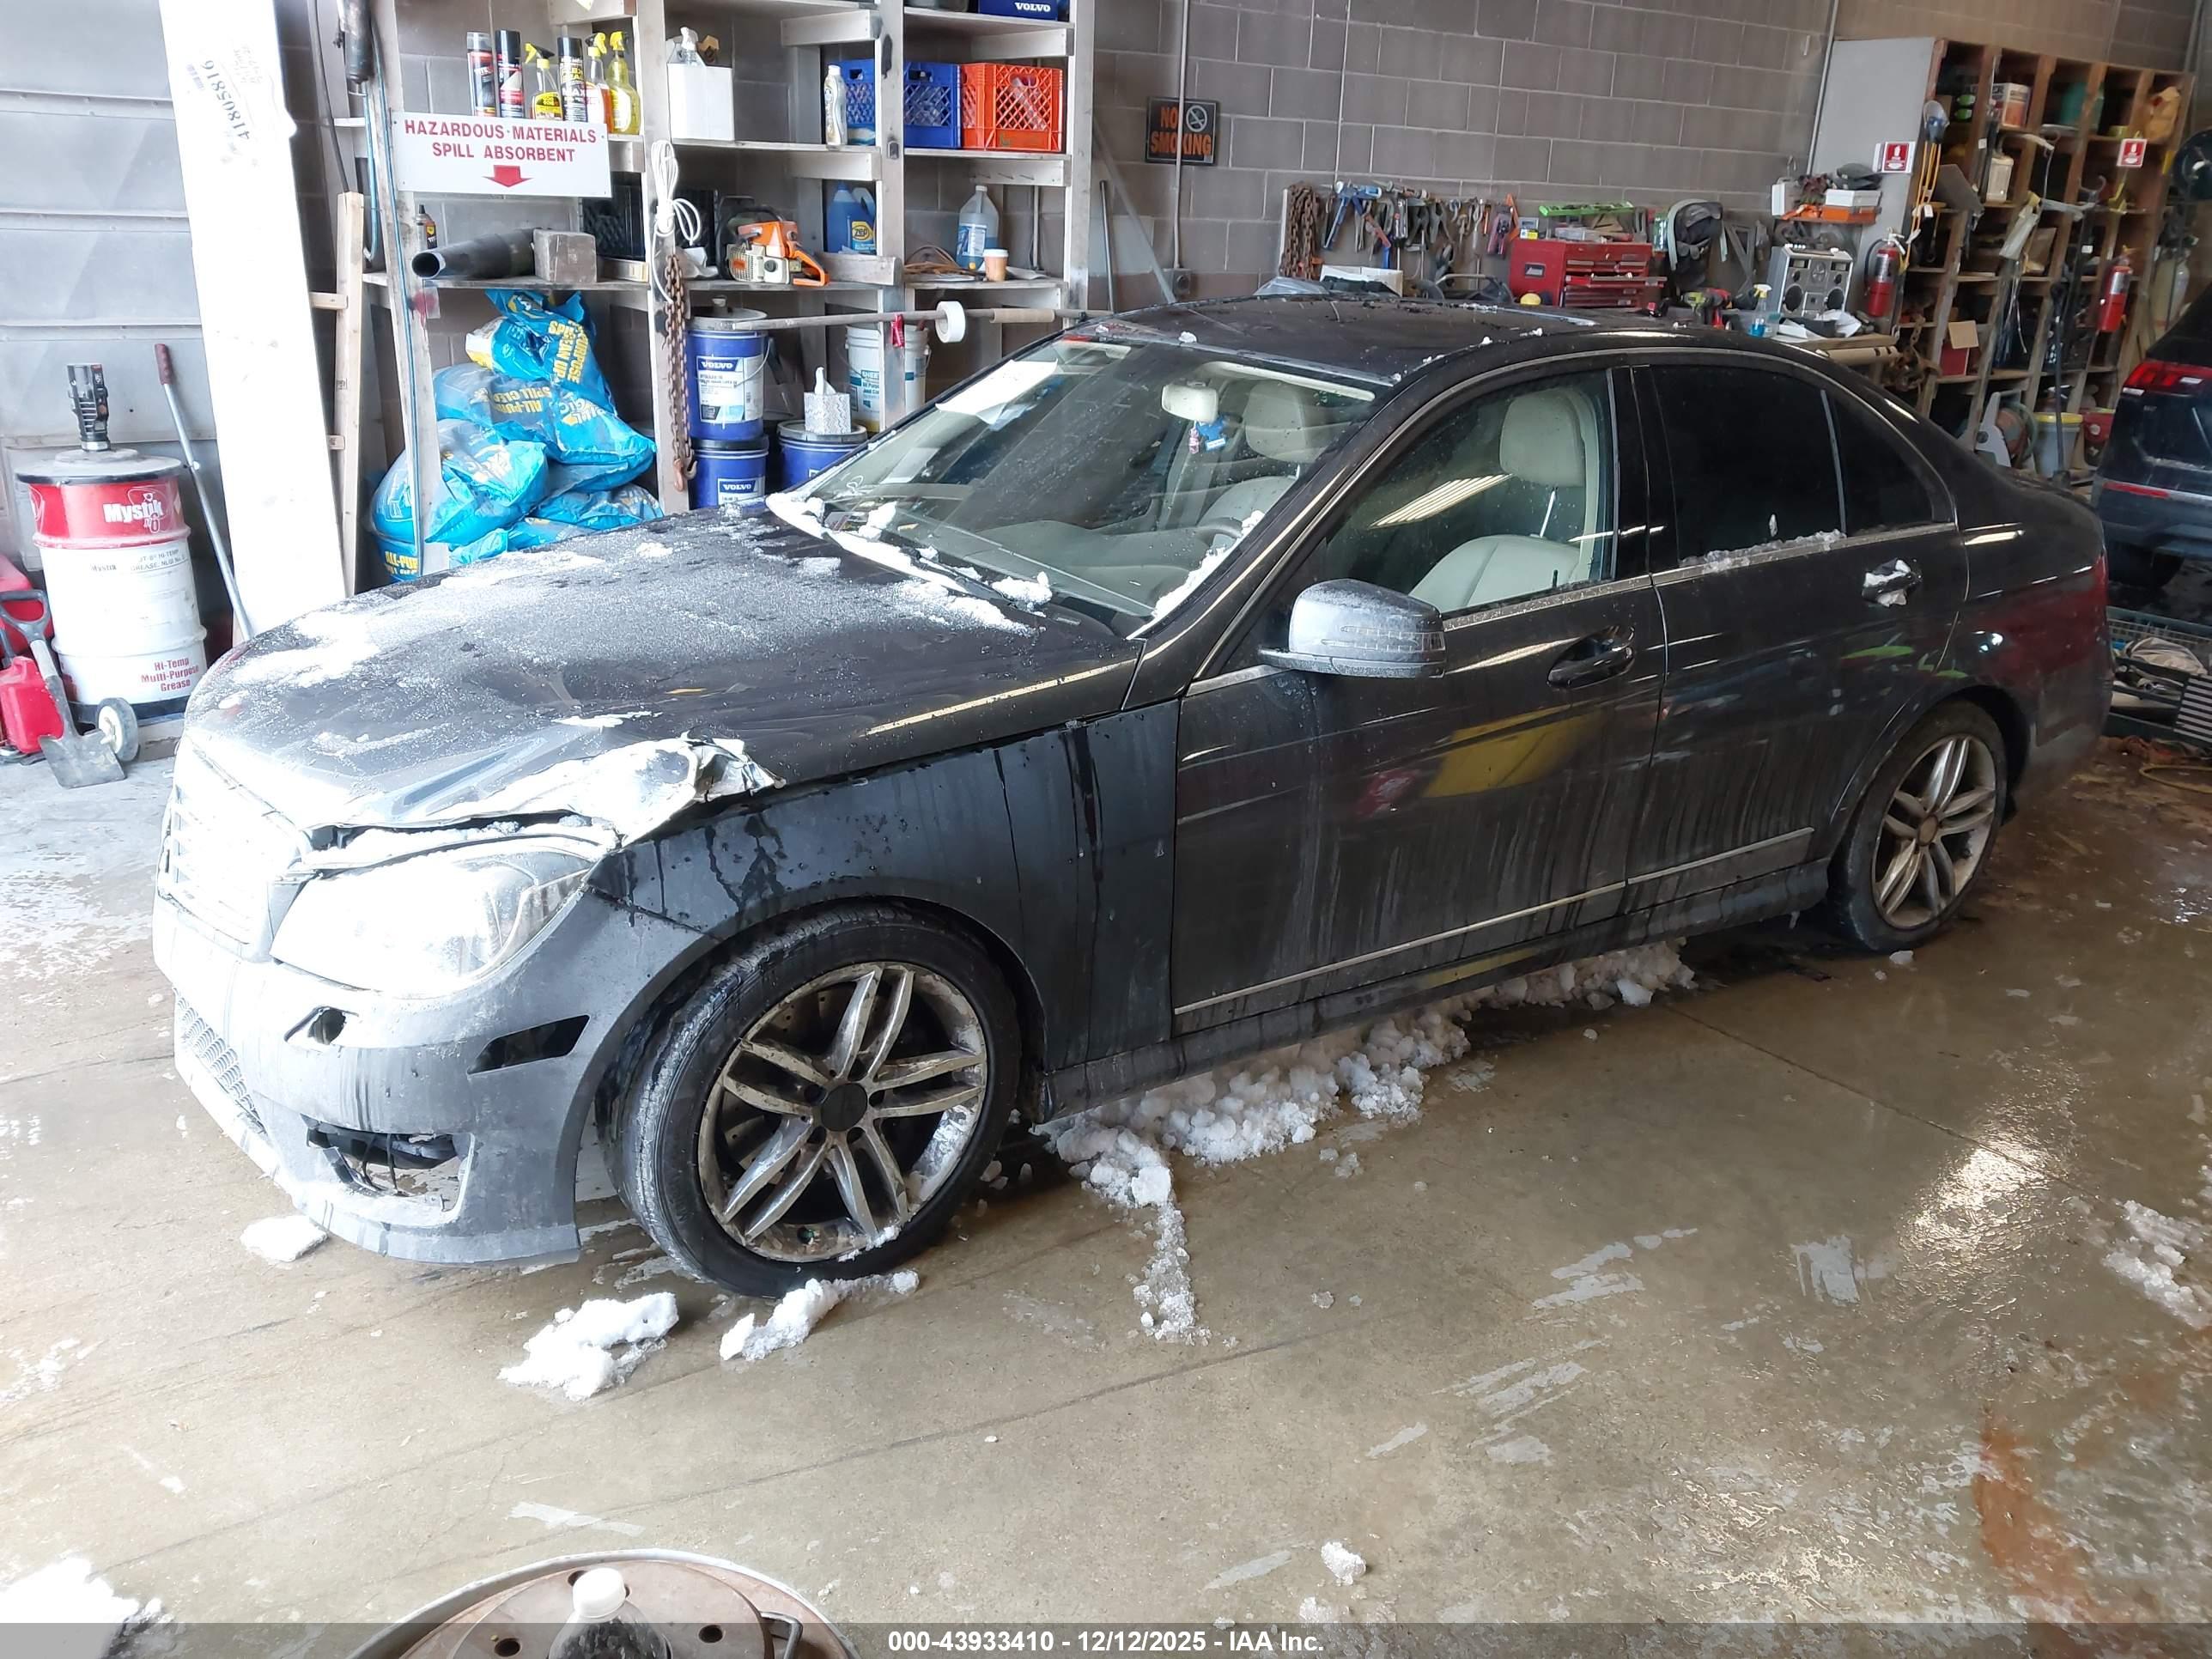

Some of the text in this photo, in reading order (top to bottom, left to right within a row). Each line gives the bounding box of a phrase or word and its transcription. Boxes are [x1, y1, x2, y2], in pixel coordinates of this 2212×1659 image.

[1014, 2, 1051, 12] VOLVO
[1160, 106, 1179, 129] NO
[404, 119, 597, 143] HAZARDOUS MATERIALS
[432, 142, 575, 162] SPILL ABSORBENT
[141, 665, 199, 684] Multi-Purpose
[154, 658, 190, 672] Hi-Temp
[161, 679, 191, 692] Grease
